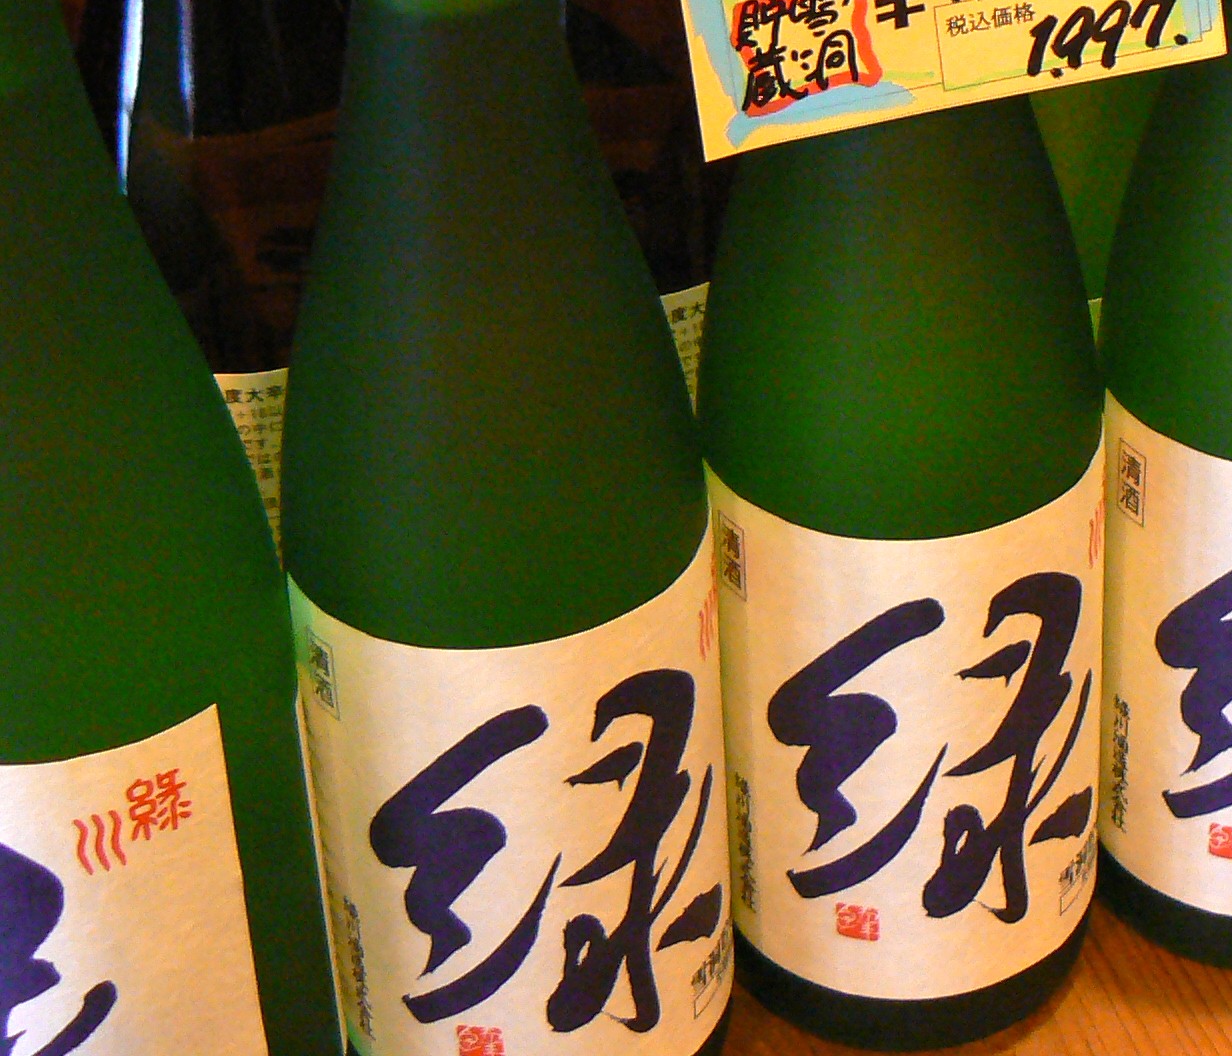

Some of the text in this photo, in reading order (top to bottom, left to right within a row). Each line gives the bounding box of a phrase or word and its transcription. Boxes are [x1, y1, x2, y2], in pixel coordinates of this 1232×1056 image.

[944, 1, 1037, 36] 税込価格
[1120, 448, 1142, 517] 清酒
